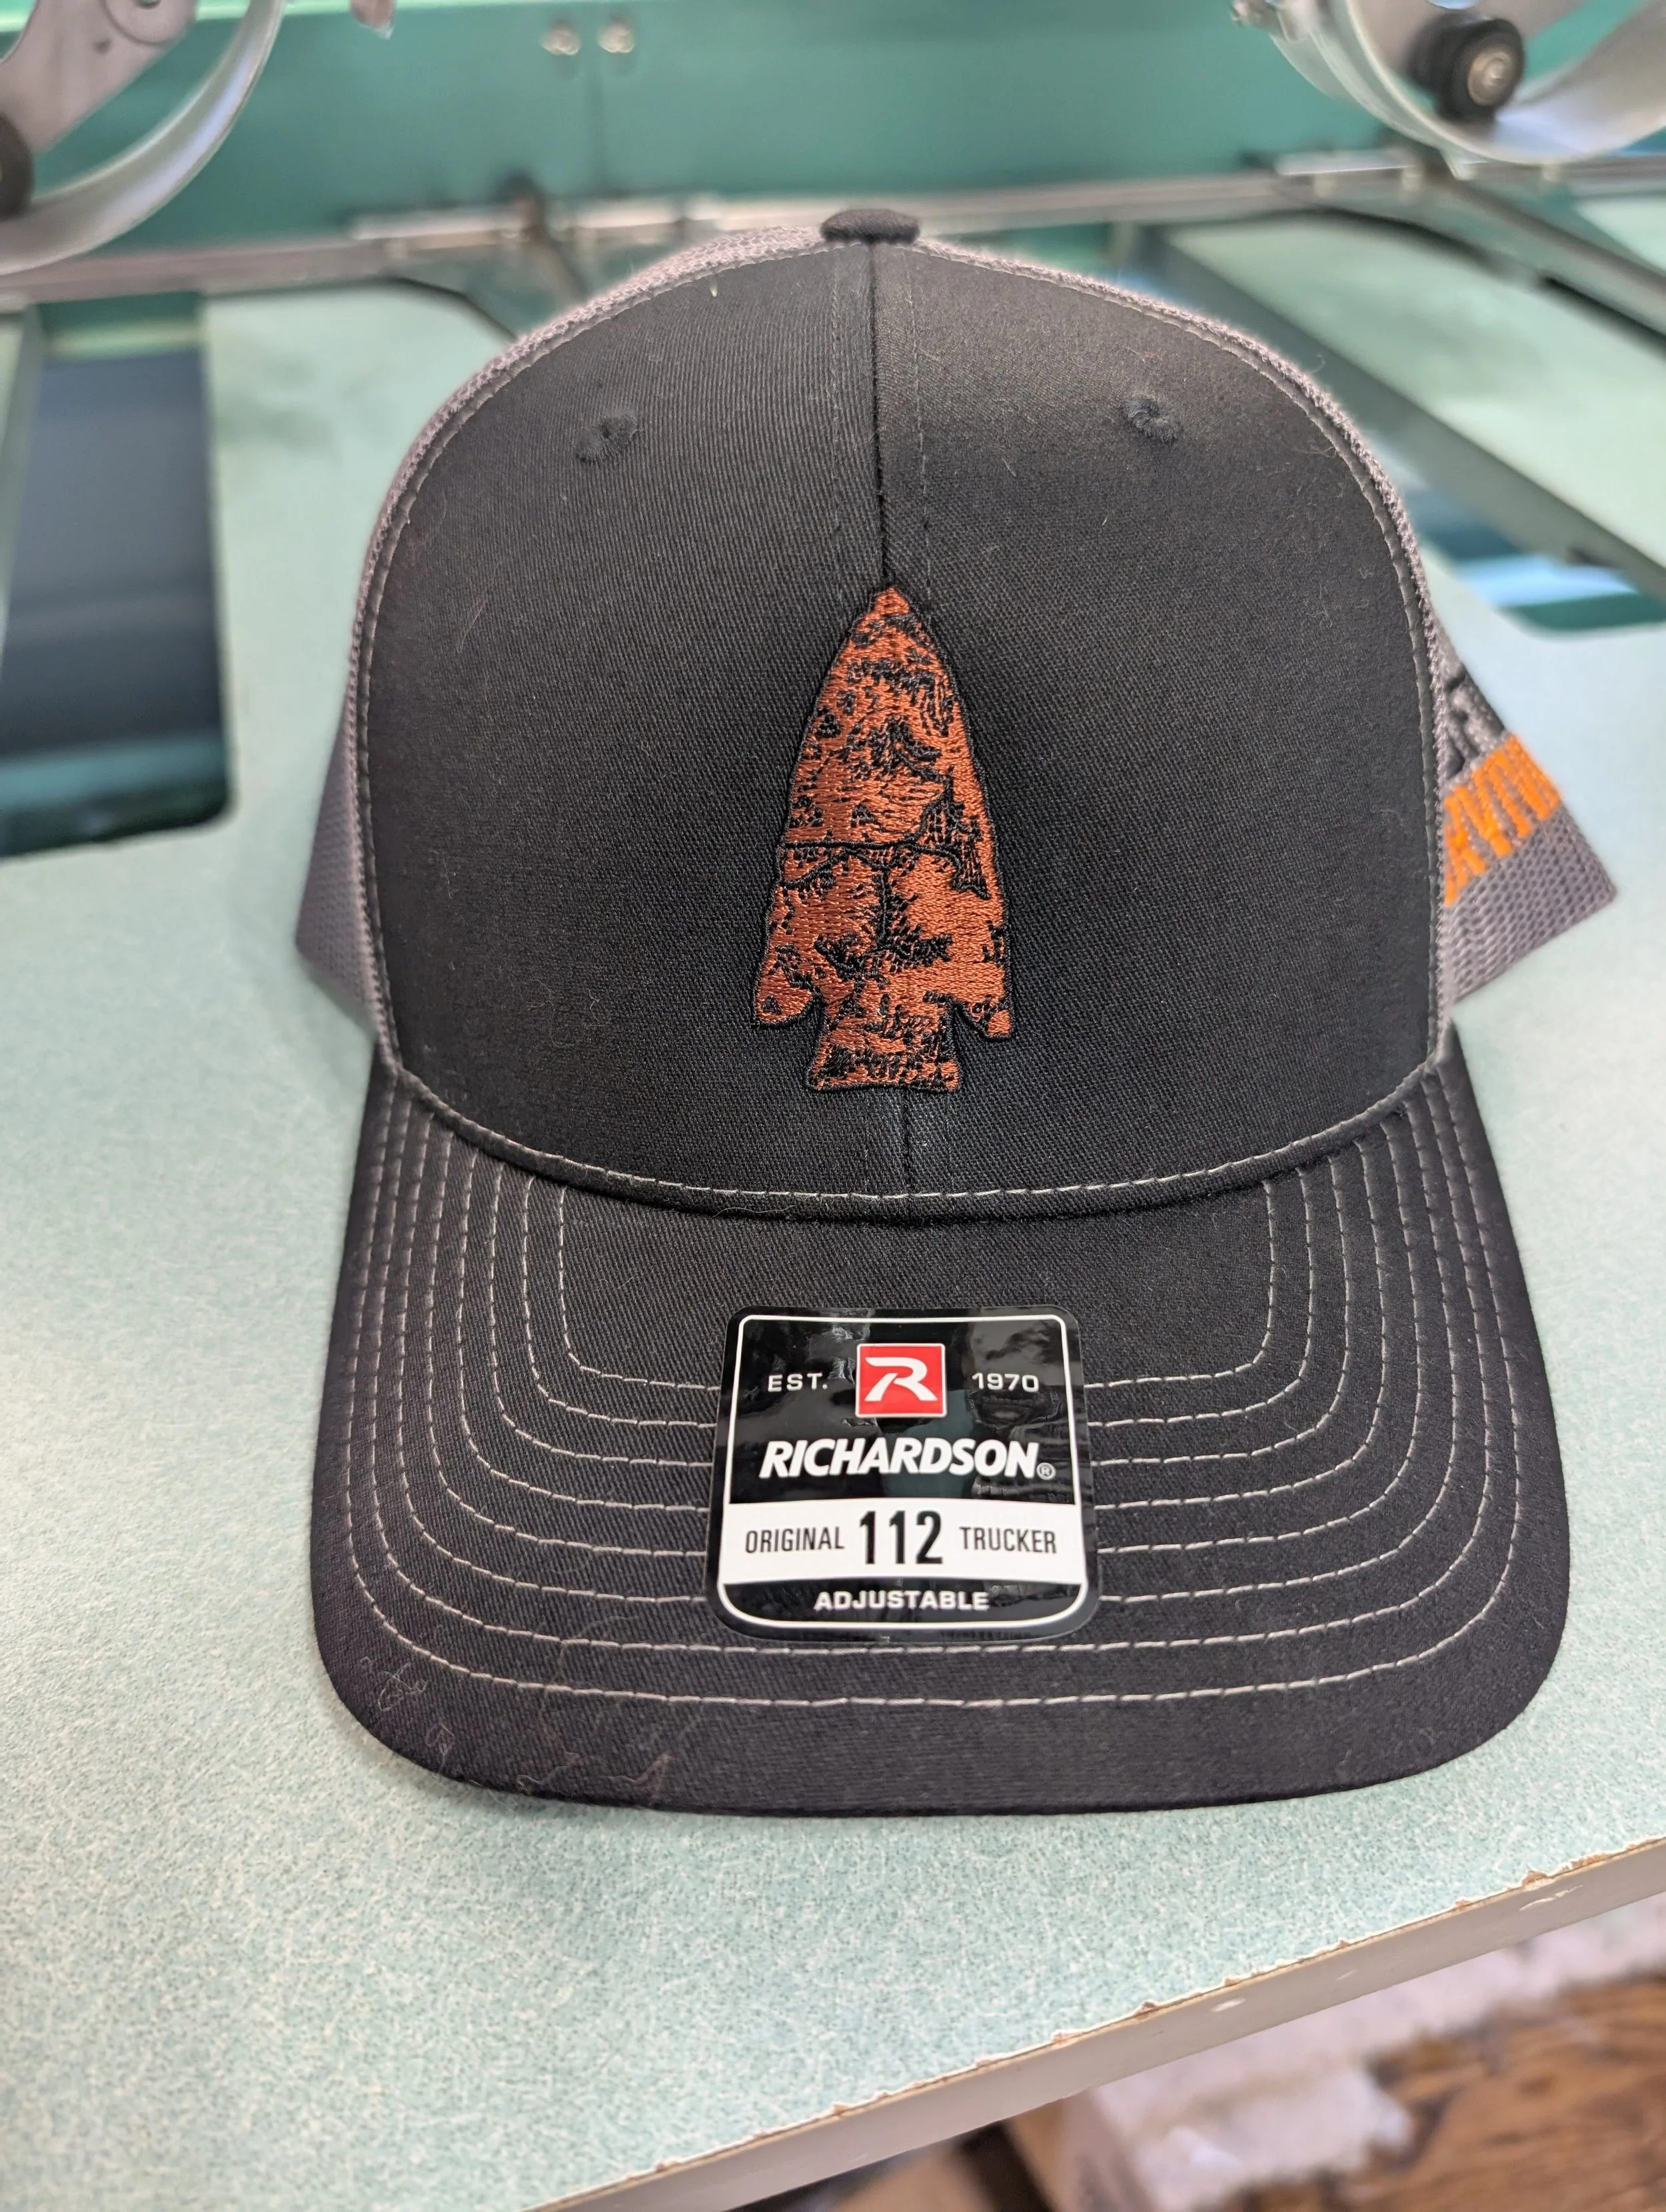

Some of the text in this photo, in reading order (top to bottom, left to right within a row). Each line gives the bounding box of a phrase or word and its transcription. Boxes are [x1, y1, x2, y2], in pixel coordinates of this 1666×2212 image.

[768, 1357, 1039, 1402] EST. R 1970
[745, 1510, 1057, 1565] ORIGINAL 112 TRUCKER
[814, 1590, 990, 1611] ADJUSTABLE
